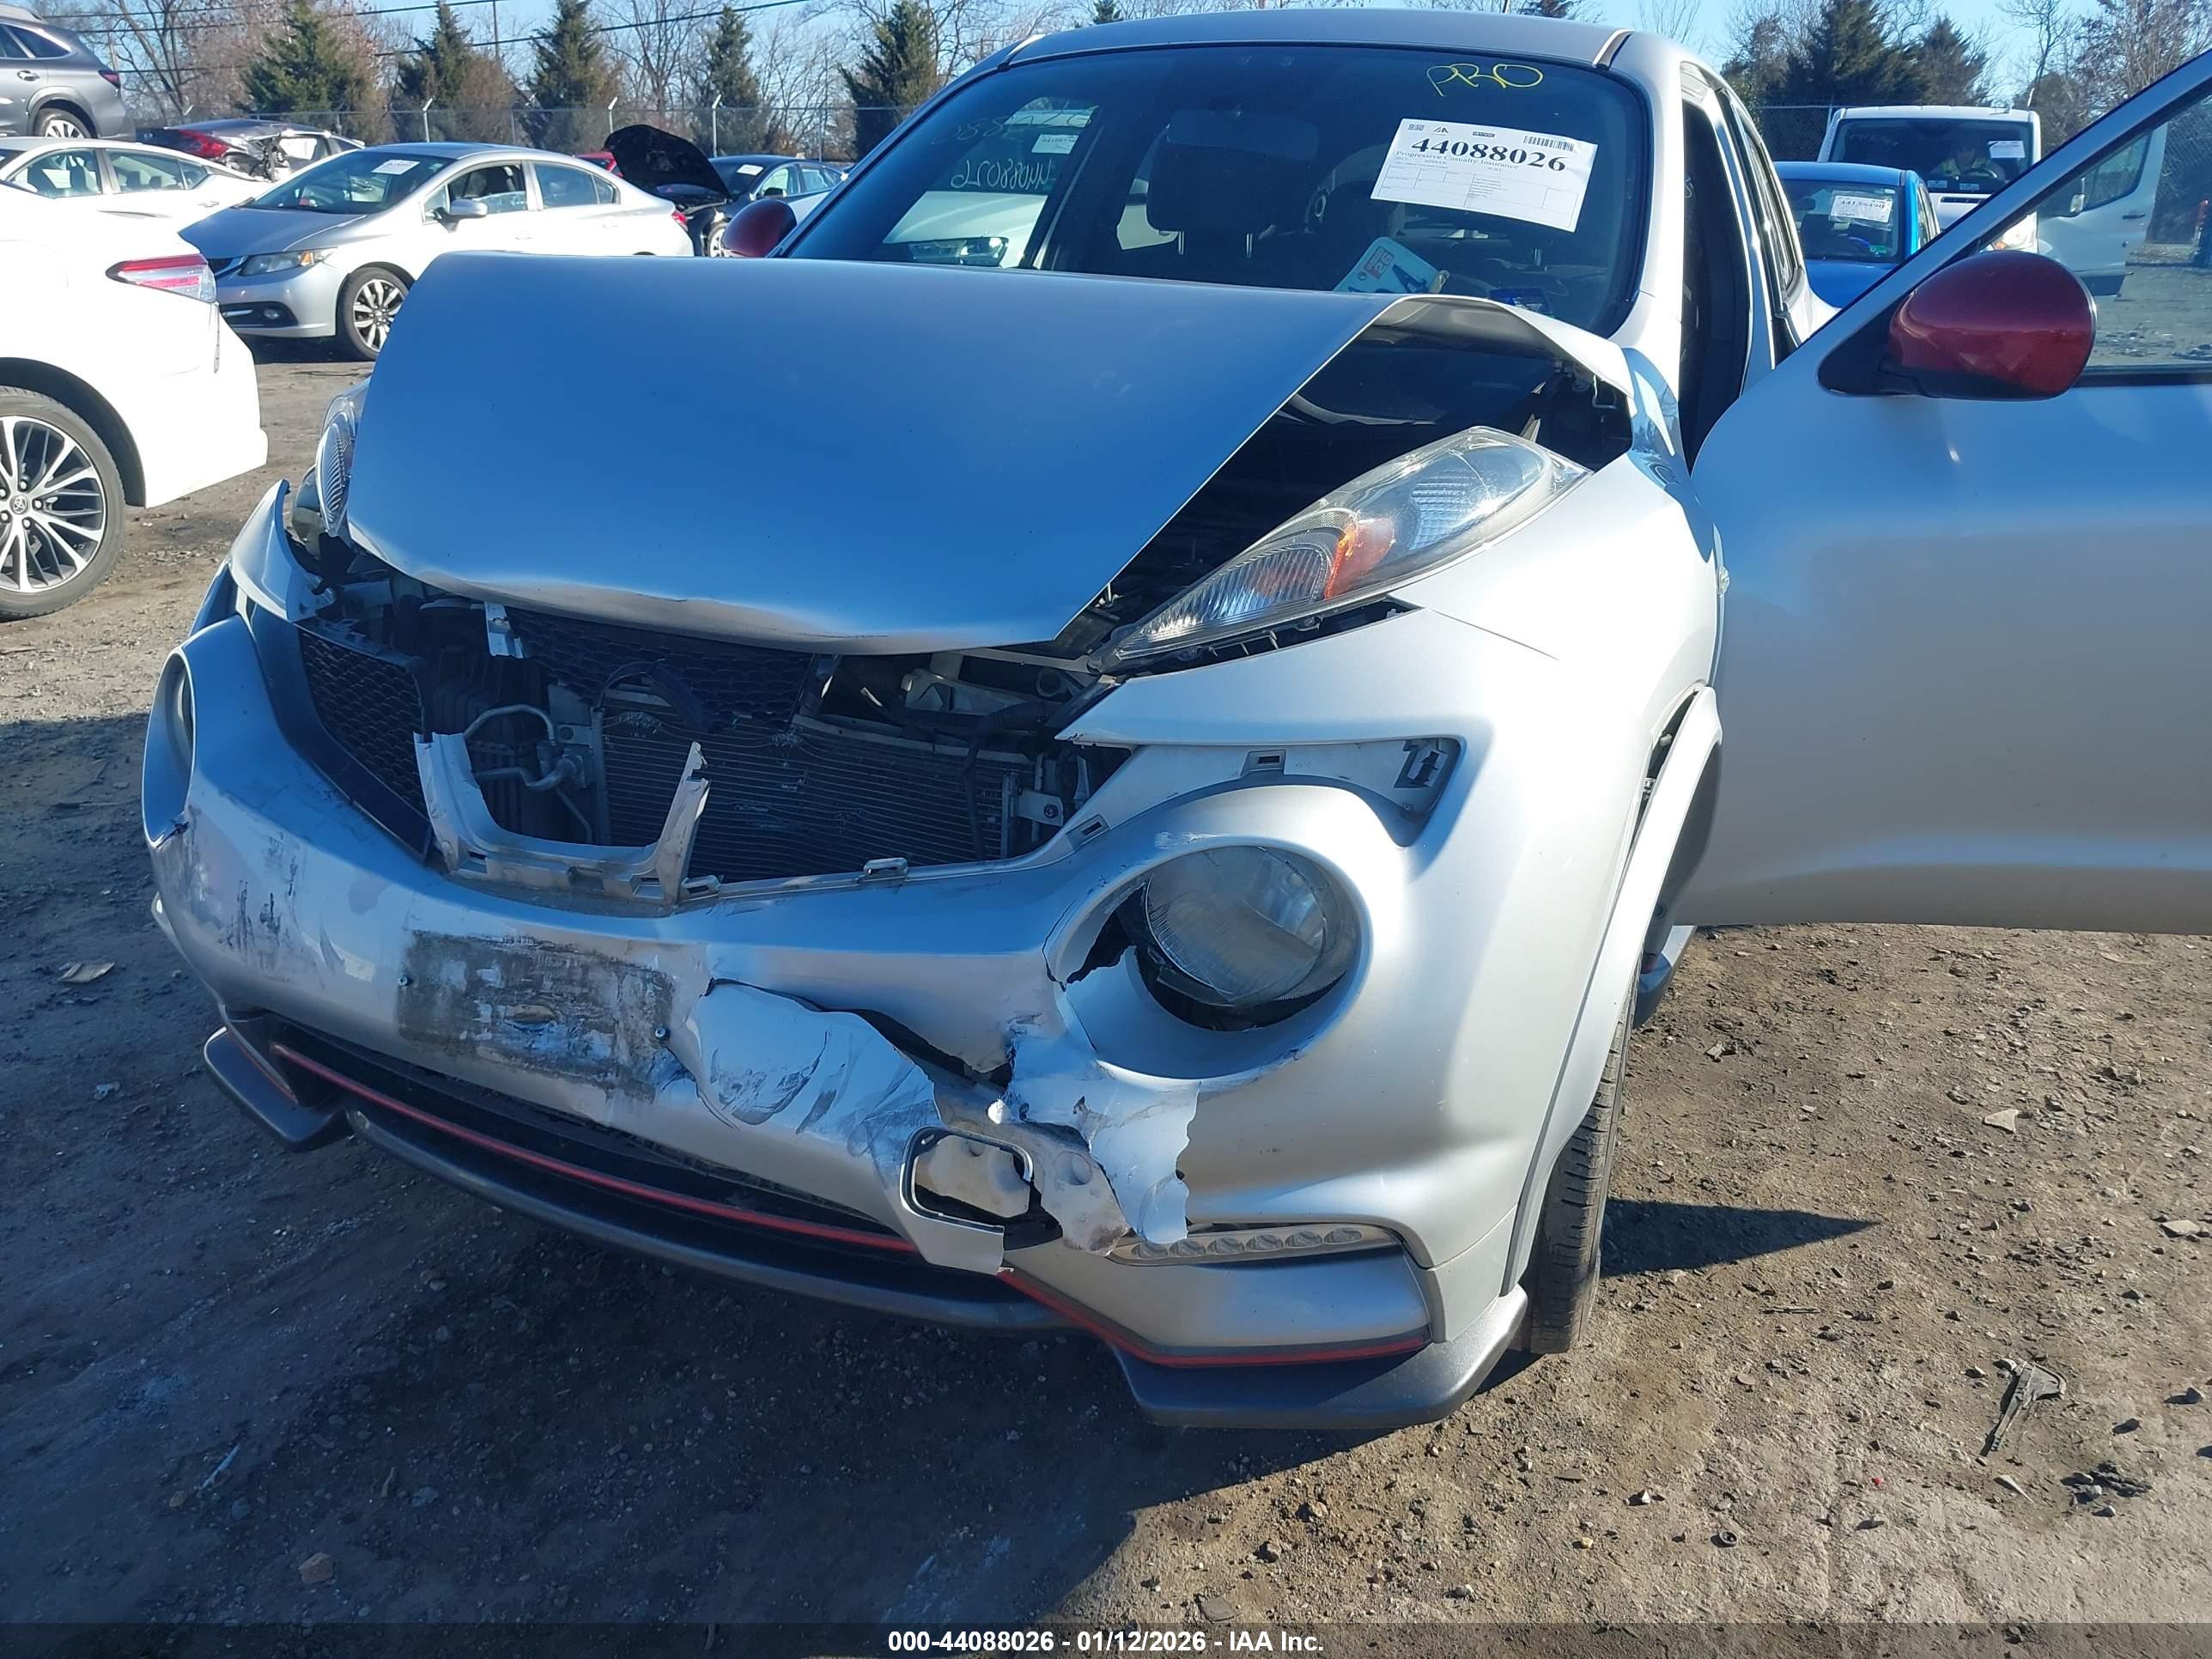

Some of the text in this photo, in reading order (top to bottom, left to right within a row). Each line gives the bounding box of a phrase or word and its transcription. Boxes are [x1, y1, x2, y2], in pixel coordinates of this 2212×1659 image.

[1395, 150, 1443, 161] Progressive
[1443, 155, 1478, 165] Casualty
[1480, 159, 1519, 170] Insurance
[1410, 137, 1569, 172] 44088026
